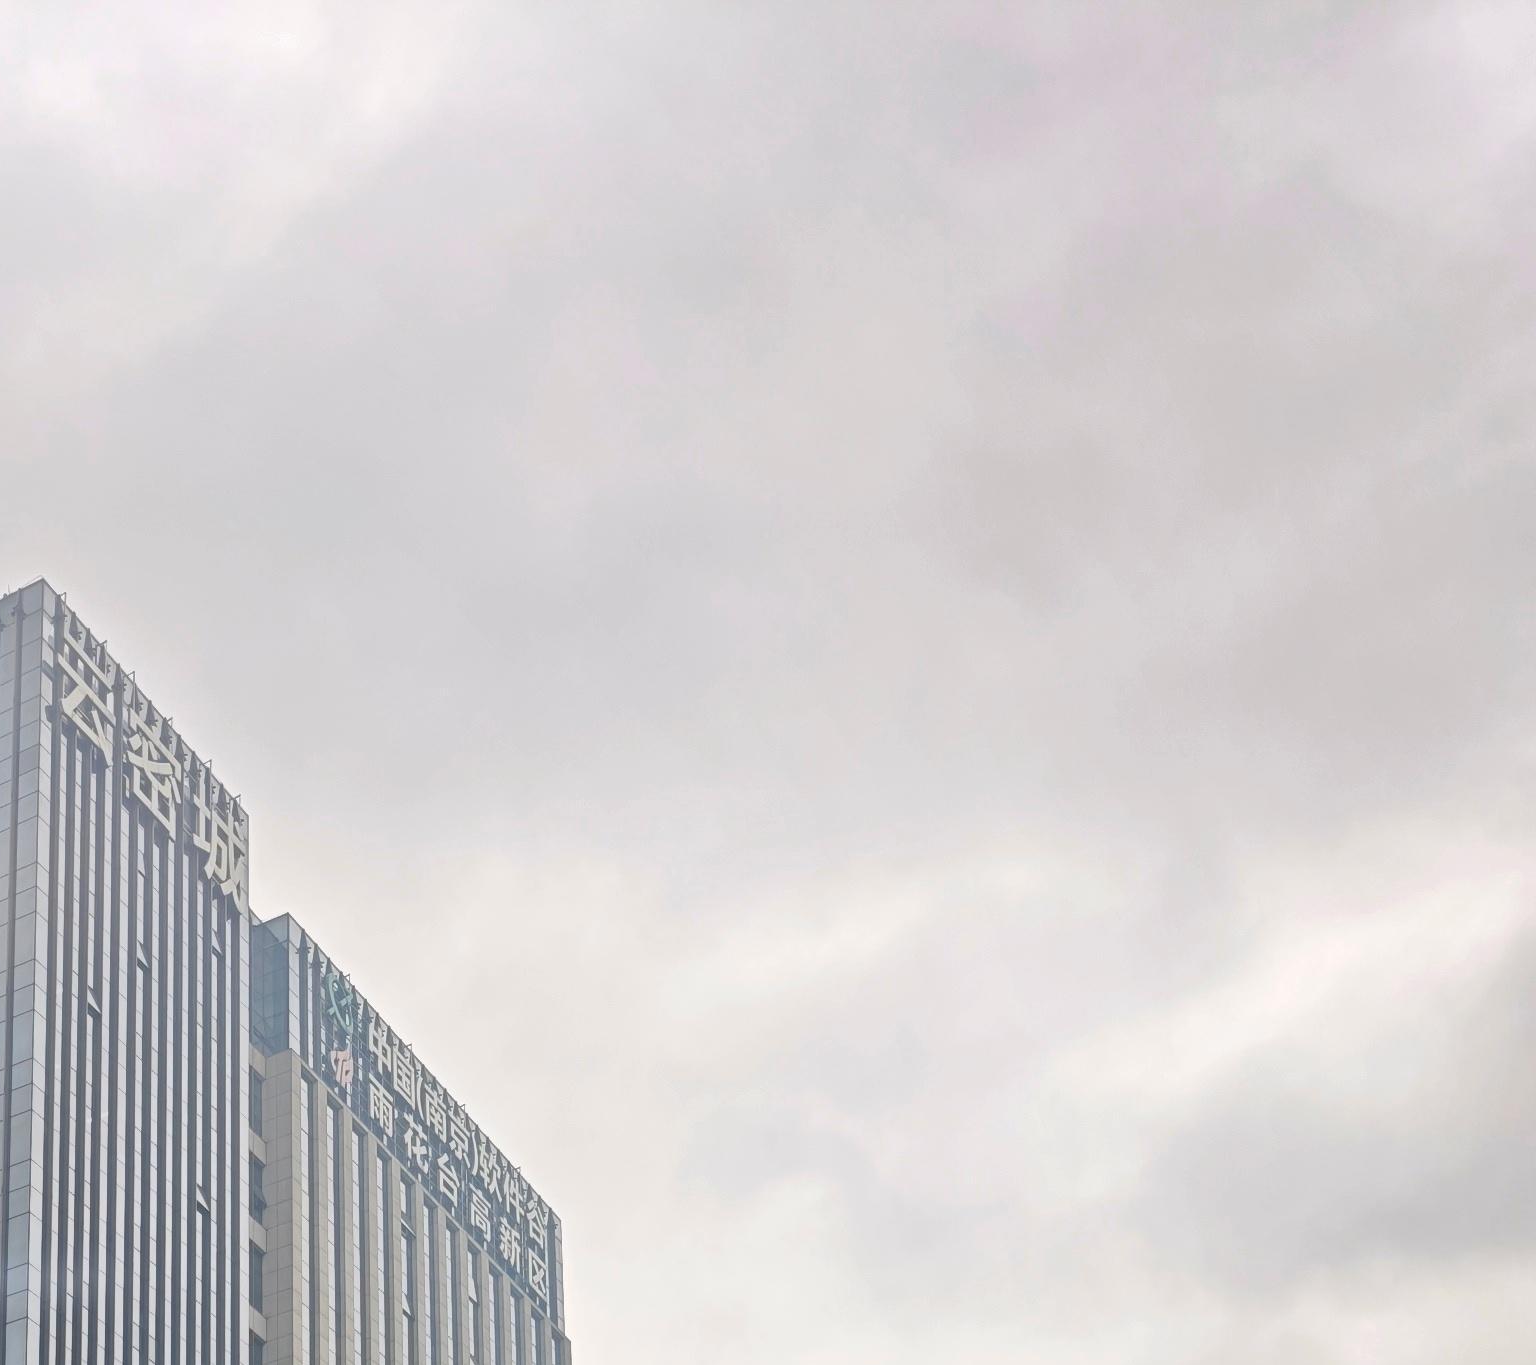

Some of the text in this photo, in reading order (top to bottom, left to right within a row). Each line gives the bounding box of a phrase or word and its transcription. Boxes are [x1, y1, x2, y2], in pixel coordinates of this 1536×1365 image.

[57, 629, 247, 915] 云密城
[368, 1018, 547, 1249] 中国（南京）软件谷
[368, 1073, 549, 1301] 雨花台高新区
